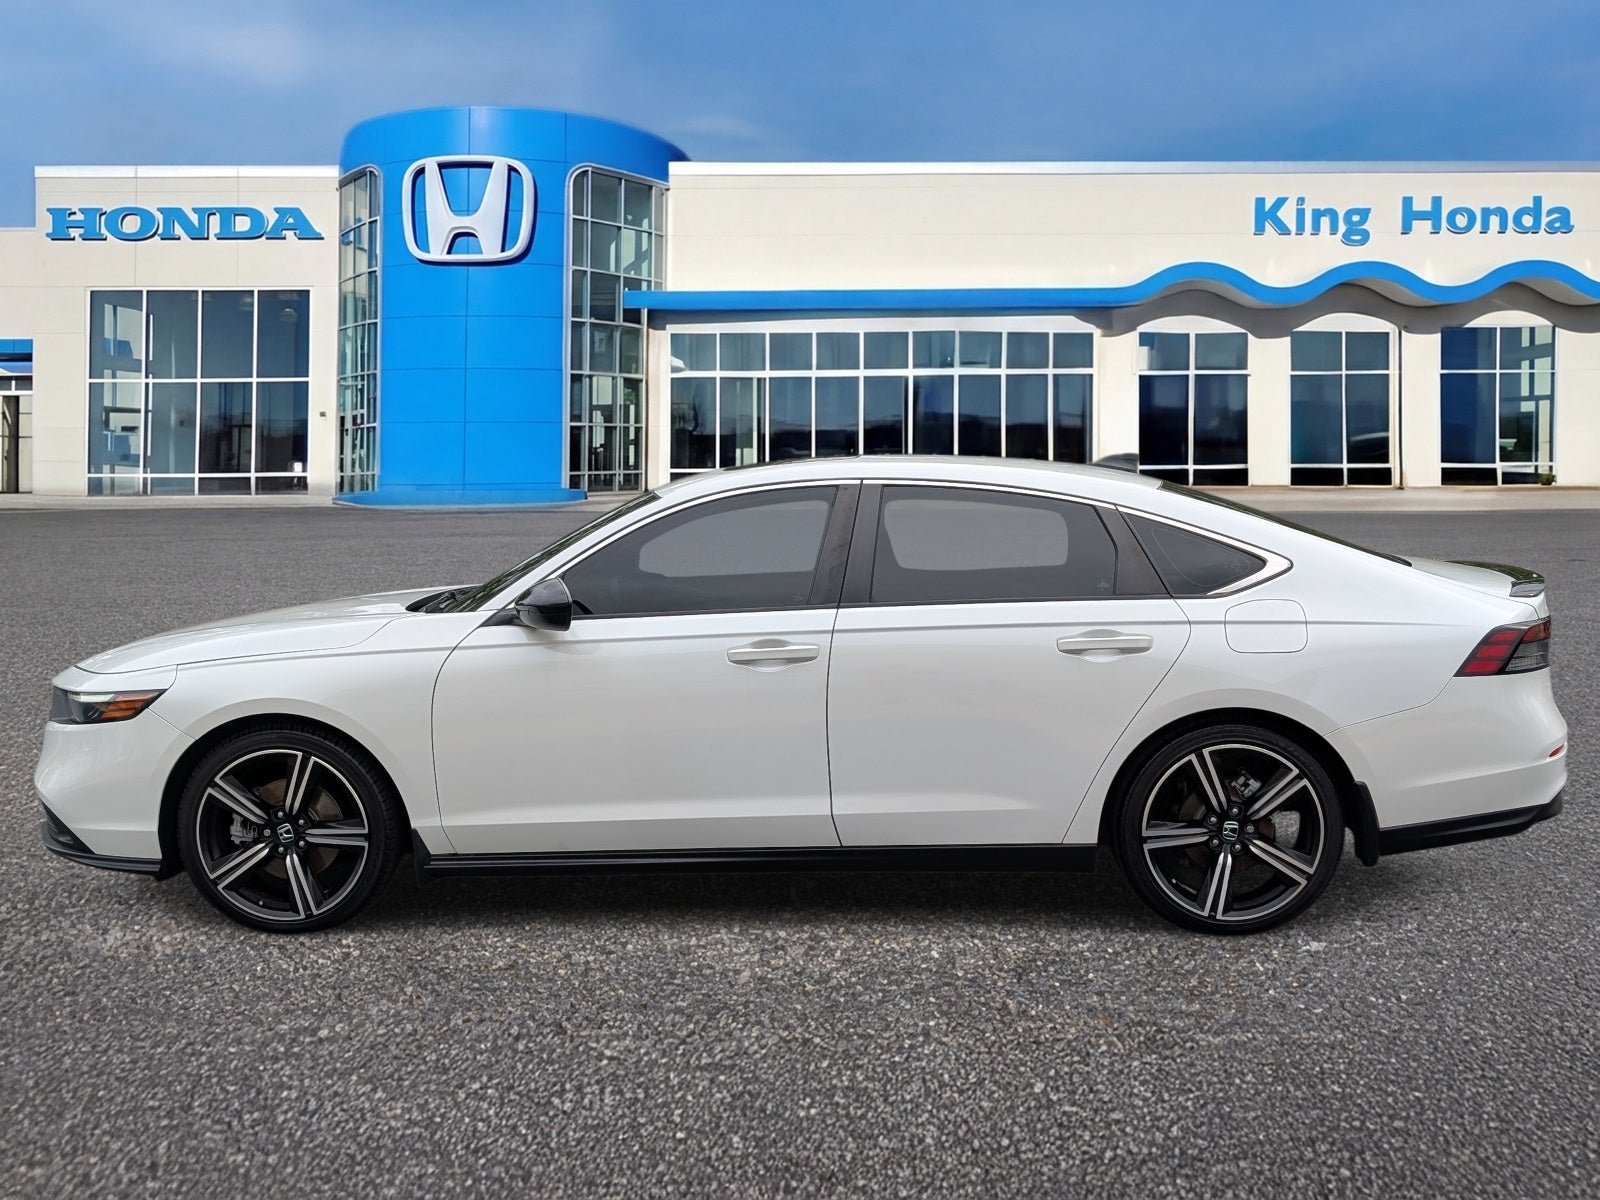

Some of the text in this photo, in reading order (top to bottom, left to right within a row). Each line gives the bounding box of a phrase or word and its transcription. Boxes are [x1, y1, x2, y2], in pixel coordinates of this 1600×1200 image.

[45, 206, 324, 241] HONDA
[1252, 195, 1575, 247] King Honda
